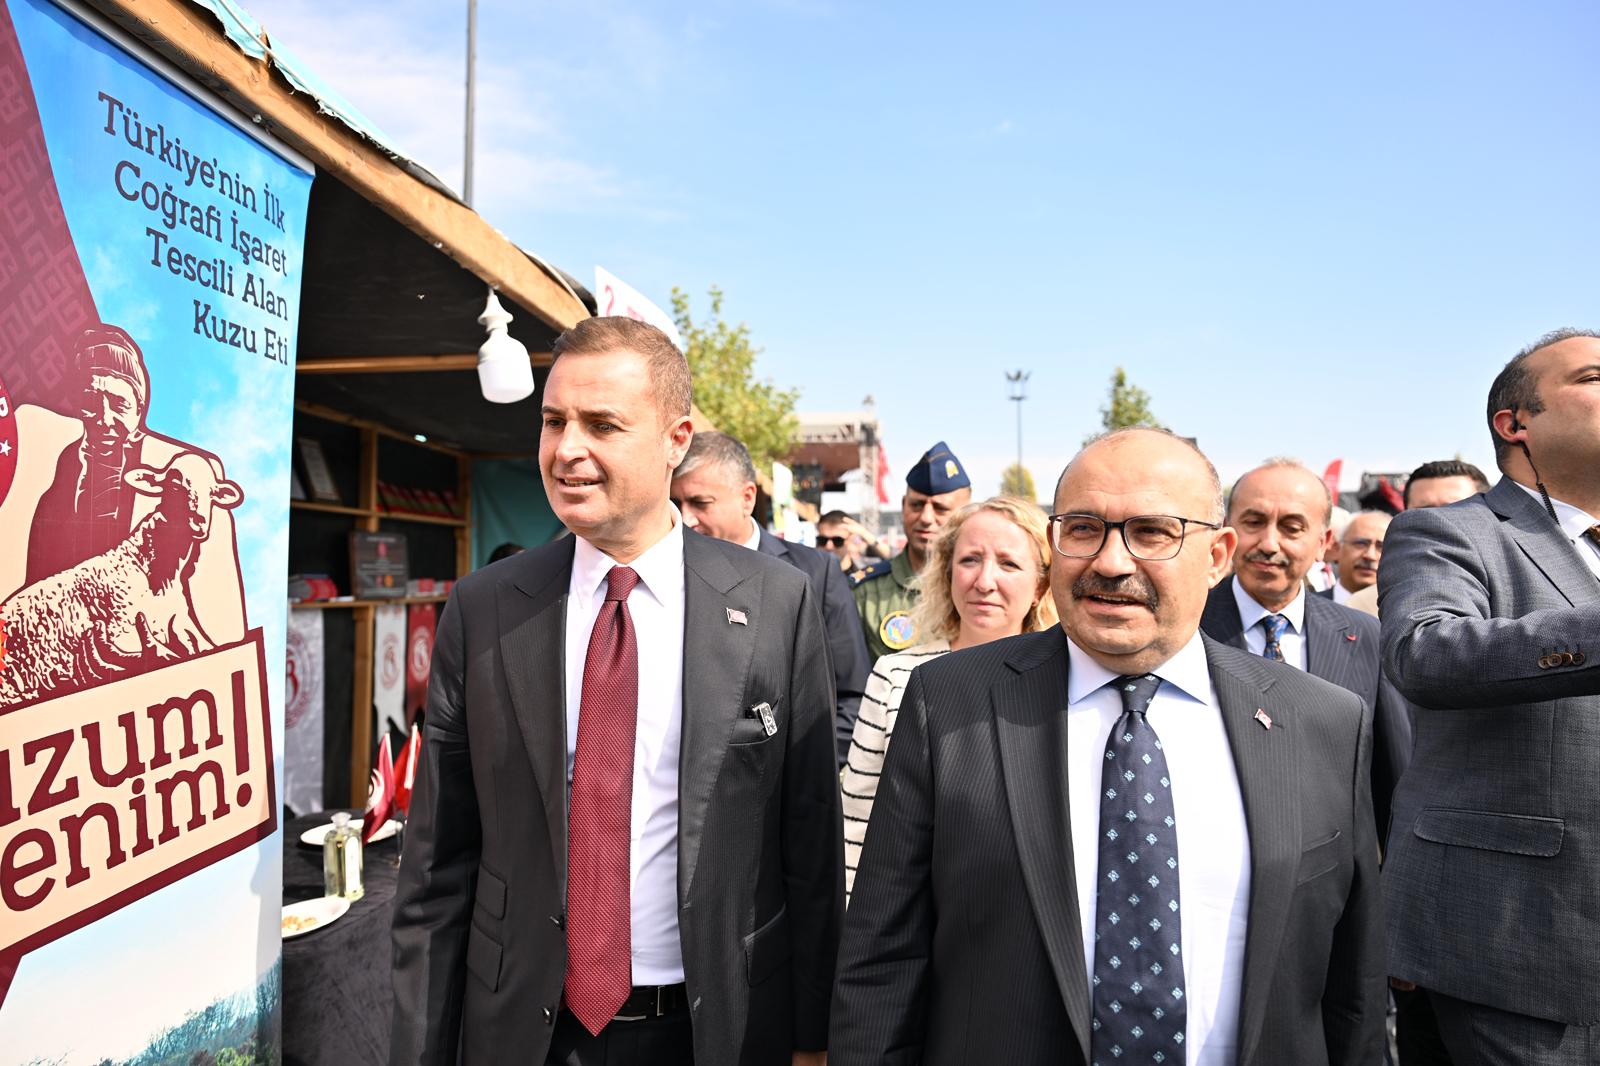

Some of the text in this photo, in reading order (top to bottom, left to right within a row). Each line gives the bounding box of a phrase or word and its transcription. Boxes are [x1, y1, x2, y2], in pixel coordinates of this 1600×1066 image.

[98, 91, 286, 233] Türkiye'nin İlk
[115, 160, 287, 277] Coğrafi İşaret
[146, 227, 288, 321] Tescili Alan
[193, 299, 288, 366] Kuzu Eti
